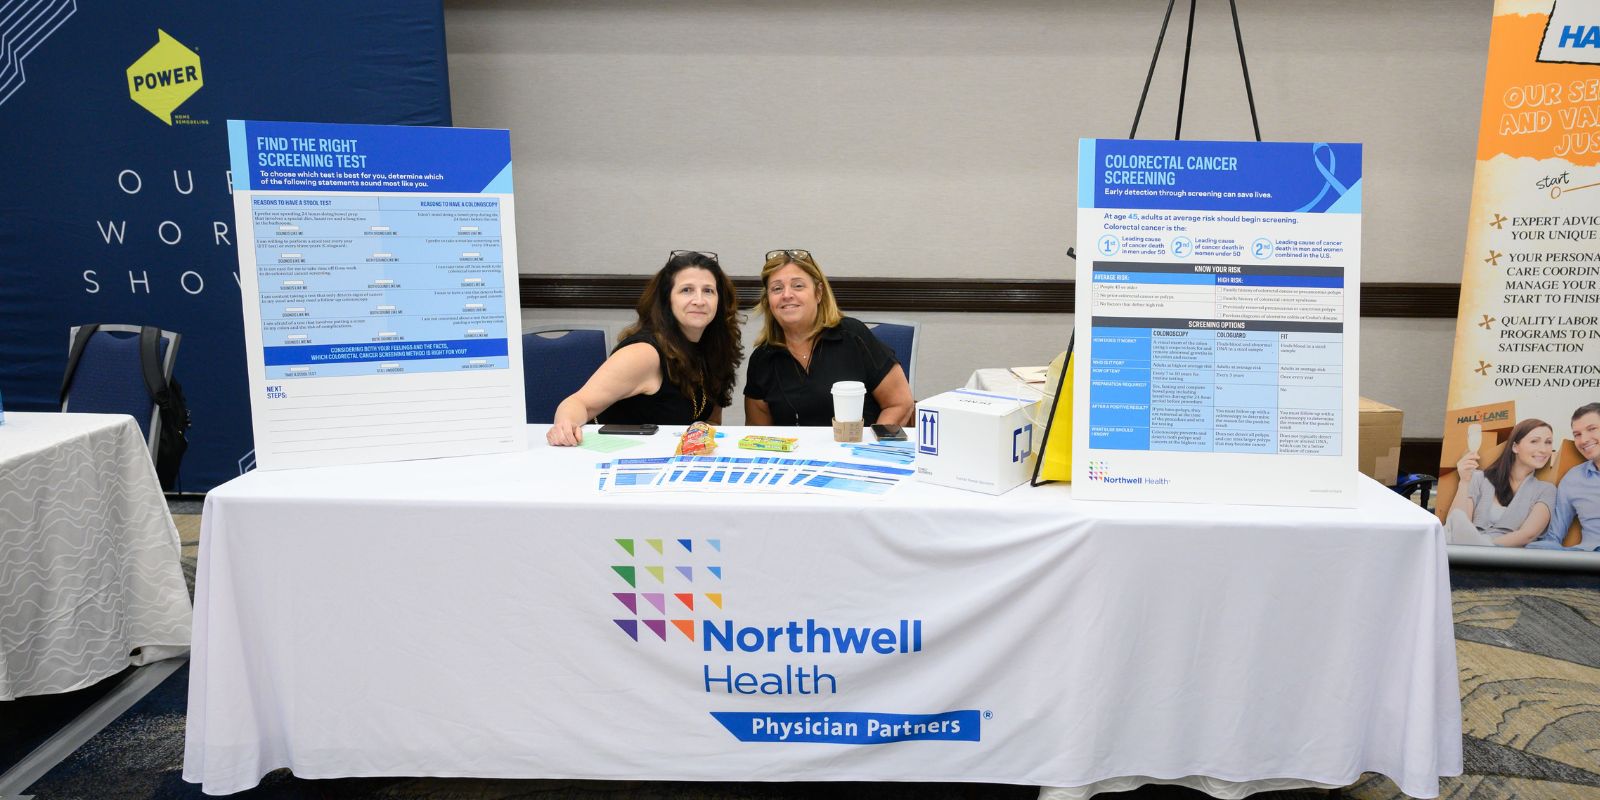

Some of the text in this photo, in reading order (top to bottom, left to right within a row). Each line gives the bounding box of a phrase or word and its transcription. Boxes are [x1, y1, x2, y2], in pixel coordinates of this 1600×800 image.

[1558, 25, 1600, 48] HA
[133, 66, 198, 92] POWER
[1504, 78, 1600, 109] OUR SE
[1500, 106, 1600, 136] AND VA
[256, 136, 358, 152] FIND THE RIGHT
[258, 152, 367, 168] SCREENING TEST
[1105, 154, 1238, 171] COLORECTAL CANCER
[1104, 170, 1176, 185] SCREENING
[1535, 170, 1570, 190] start
[1104, 188, 1123, 196] Early
[1512, 216, 1560, 226] EXPERT
[1512, 230, 1597, 242] YOUR UNIQUE
[1509, 253, 1543, 262] YOUR
[1507, 266, 1600, 276] CARE COORDIN
[1505, 280, 1596, 290] MANAGE YOUR
[1504, 294, 1542, 304] START
[1544, 294, 1561, 304] TO
[1501, 316, 1598, 327] QUALITY LABOR
[1500, 329, 1568, 339] PROGRAMS
[1569, 329, 1586, 339] TO
[1498, 343, 1584, 353] SATISFACTION
[1496, 364, 1600, 374] 3RD GENERATION
[1494, 378, 1541, 387] OWNED
[1543, 378, 1570, 388] AND
[1104, 476, 1169, 485] Northwell Health
[702, 618, 922, 654] Northwell
[704, 664, 836, 694] Health
[752, 716, 960, 741] Physician Partners
